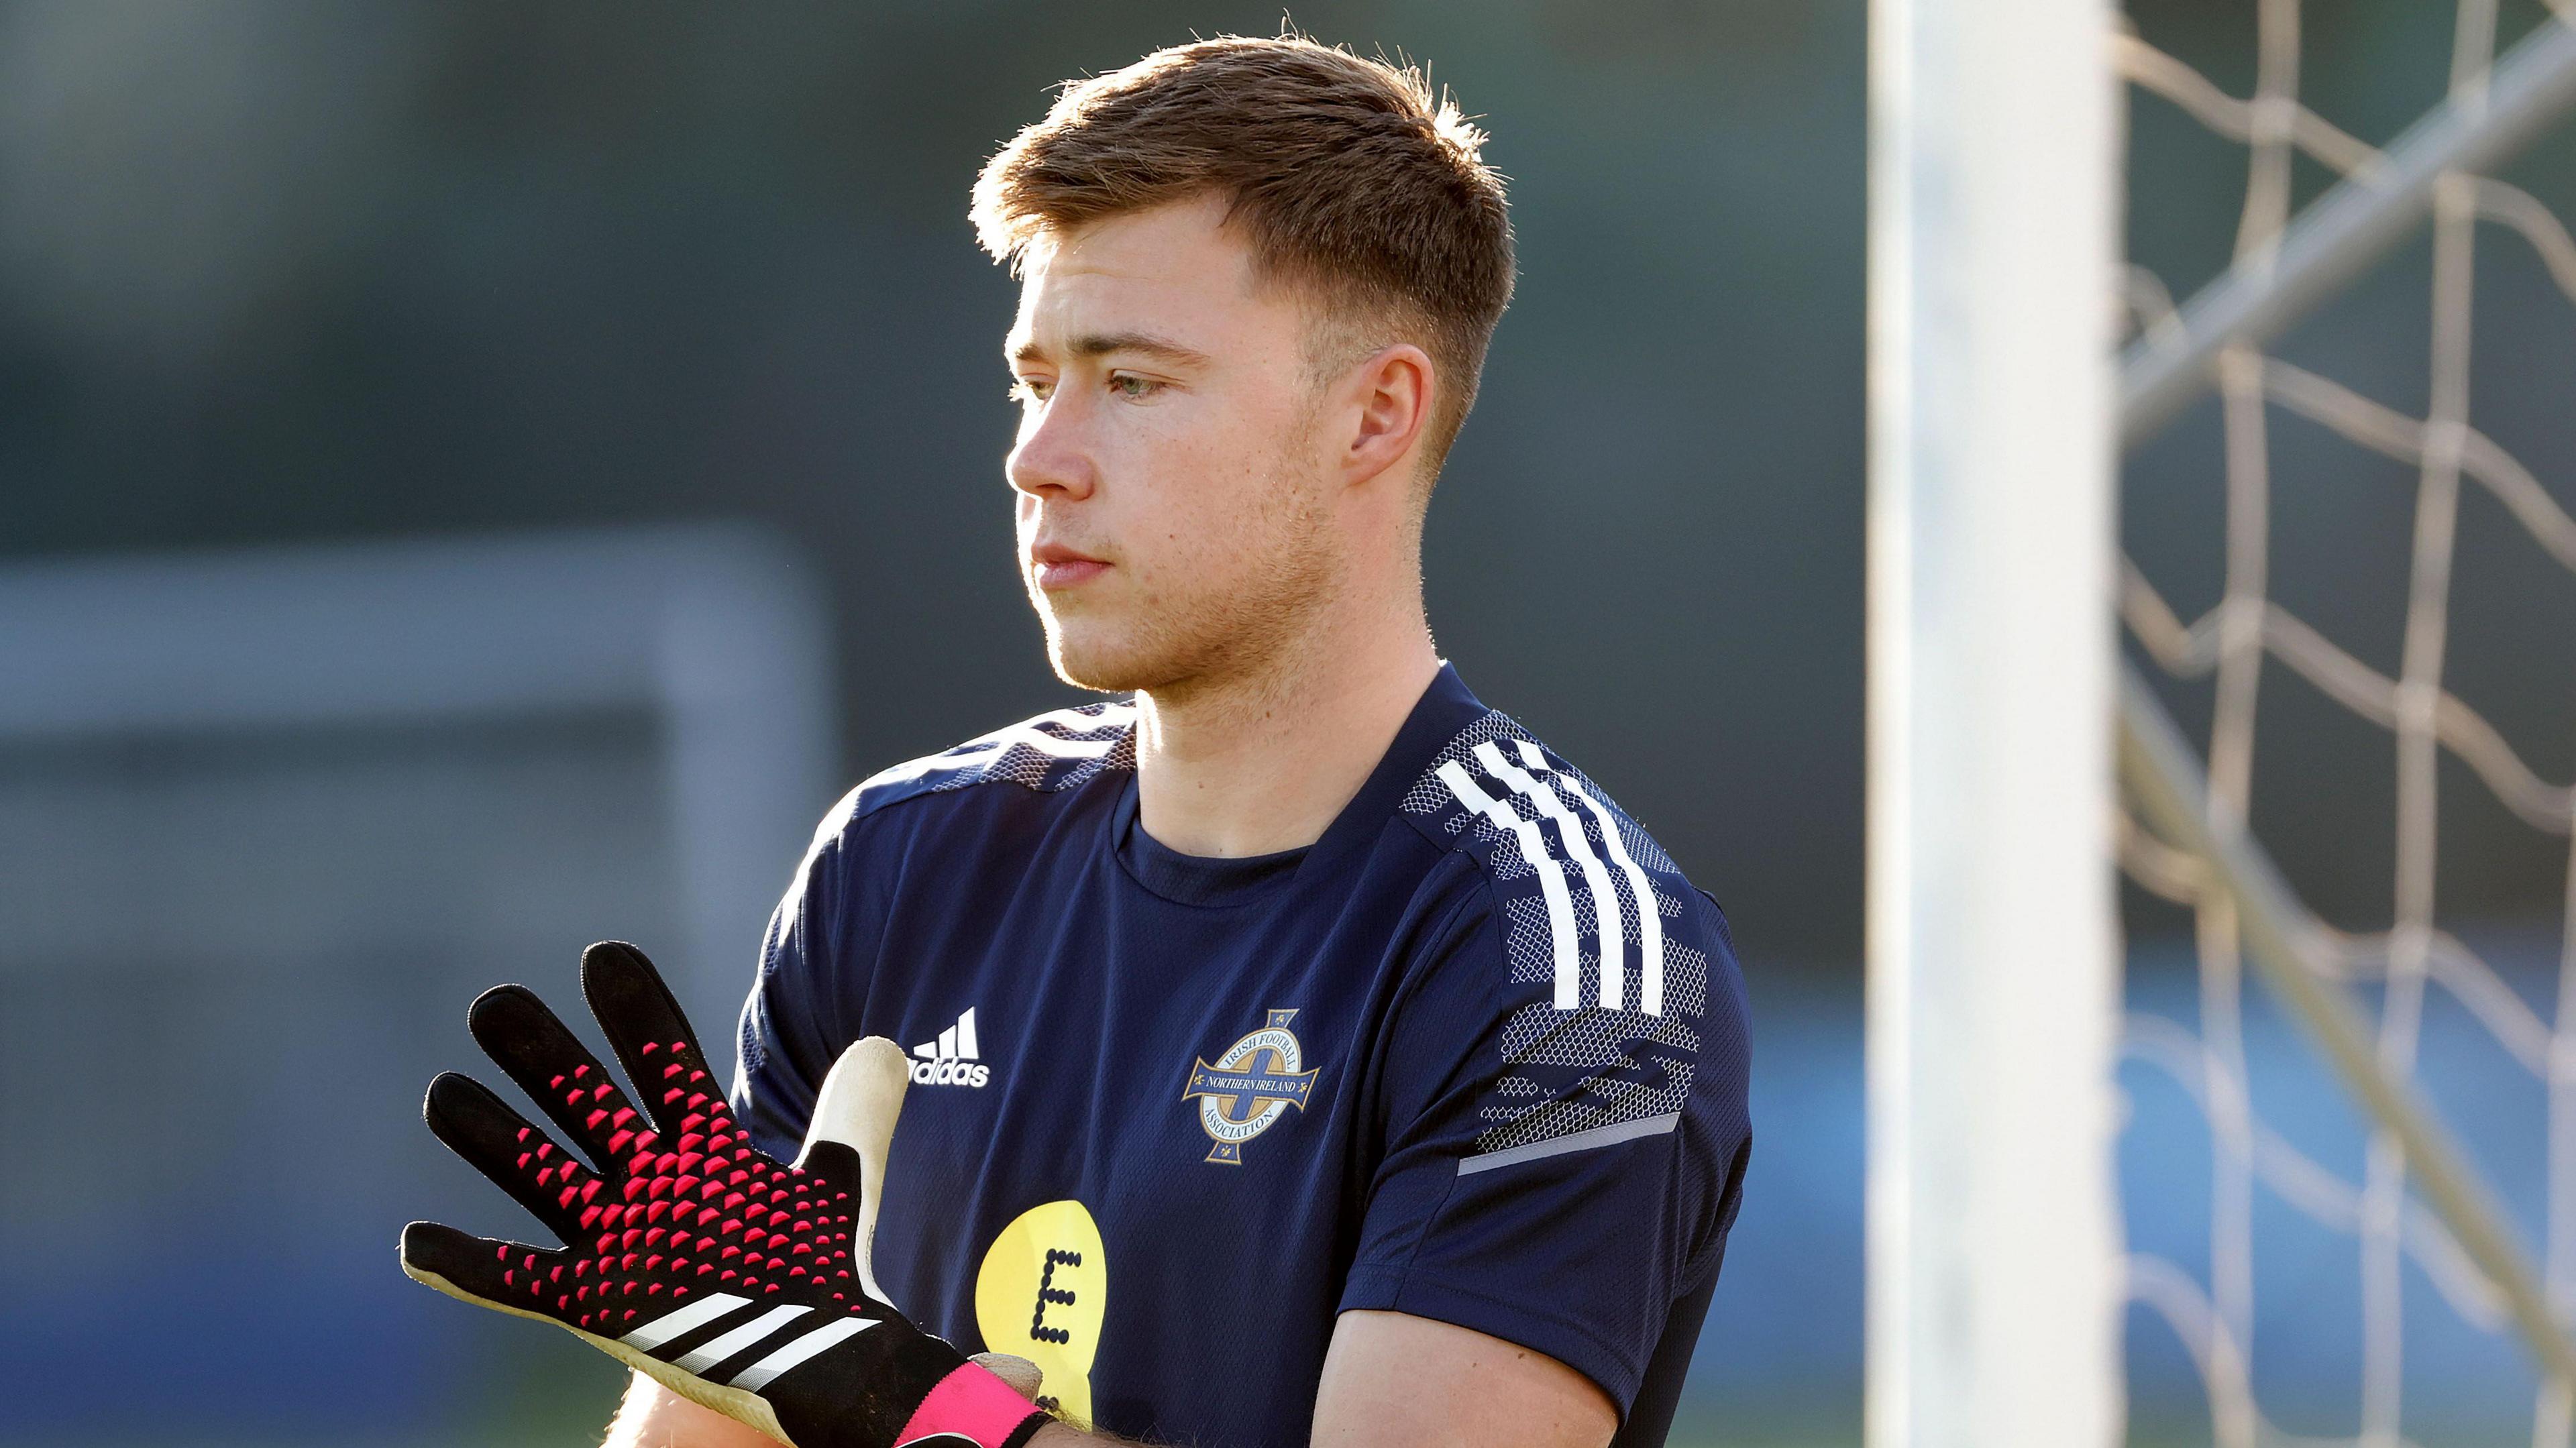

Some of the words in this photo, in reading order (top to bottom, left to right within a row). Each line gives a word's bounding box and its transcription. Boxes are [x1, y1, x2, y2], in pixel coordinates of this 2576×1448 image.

[1225, 1036, 1257, 1066] IRISH
[1259, 1033, 1296, 1069] FOOTBALL
[1206, 1075, 1255, 1090] NORTHERN
[1256, 1079, 1296, 1092] IRELAND
[1205, 1107, 1273, 1138] ASSOCIATION
[1030, 1248, 1081, 1345] E
